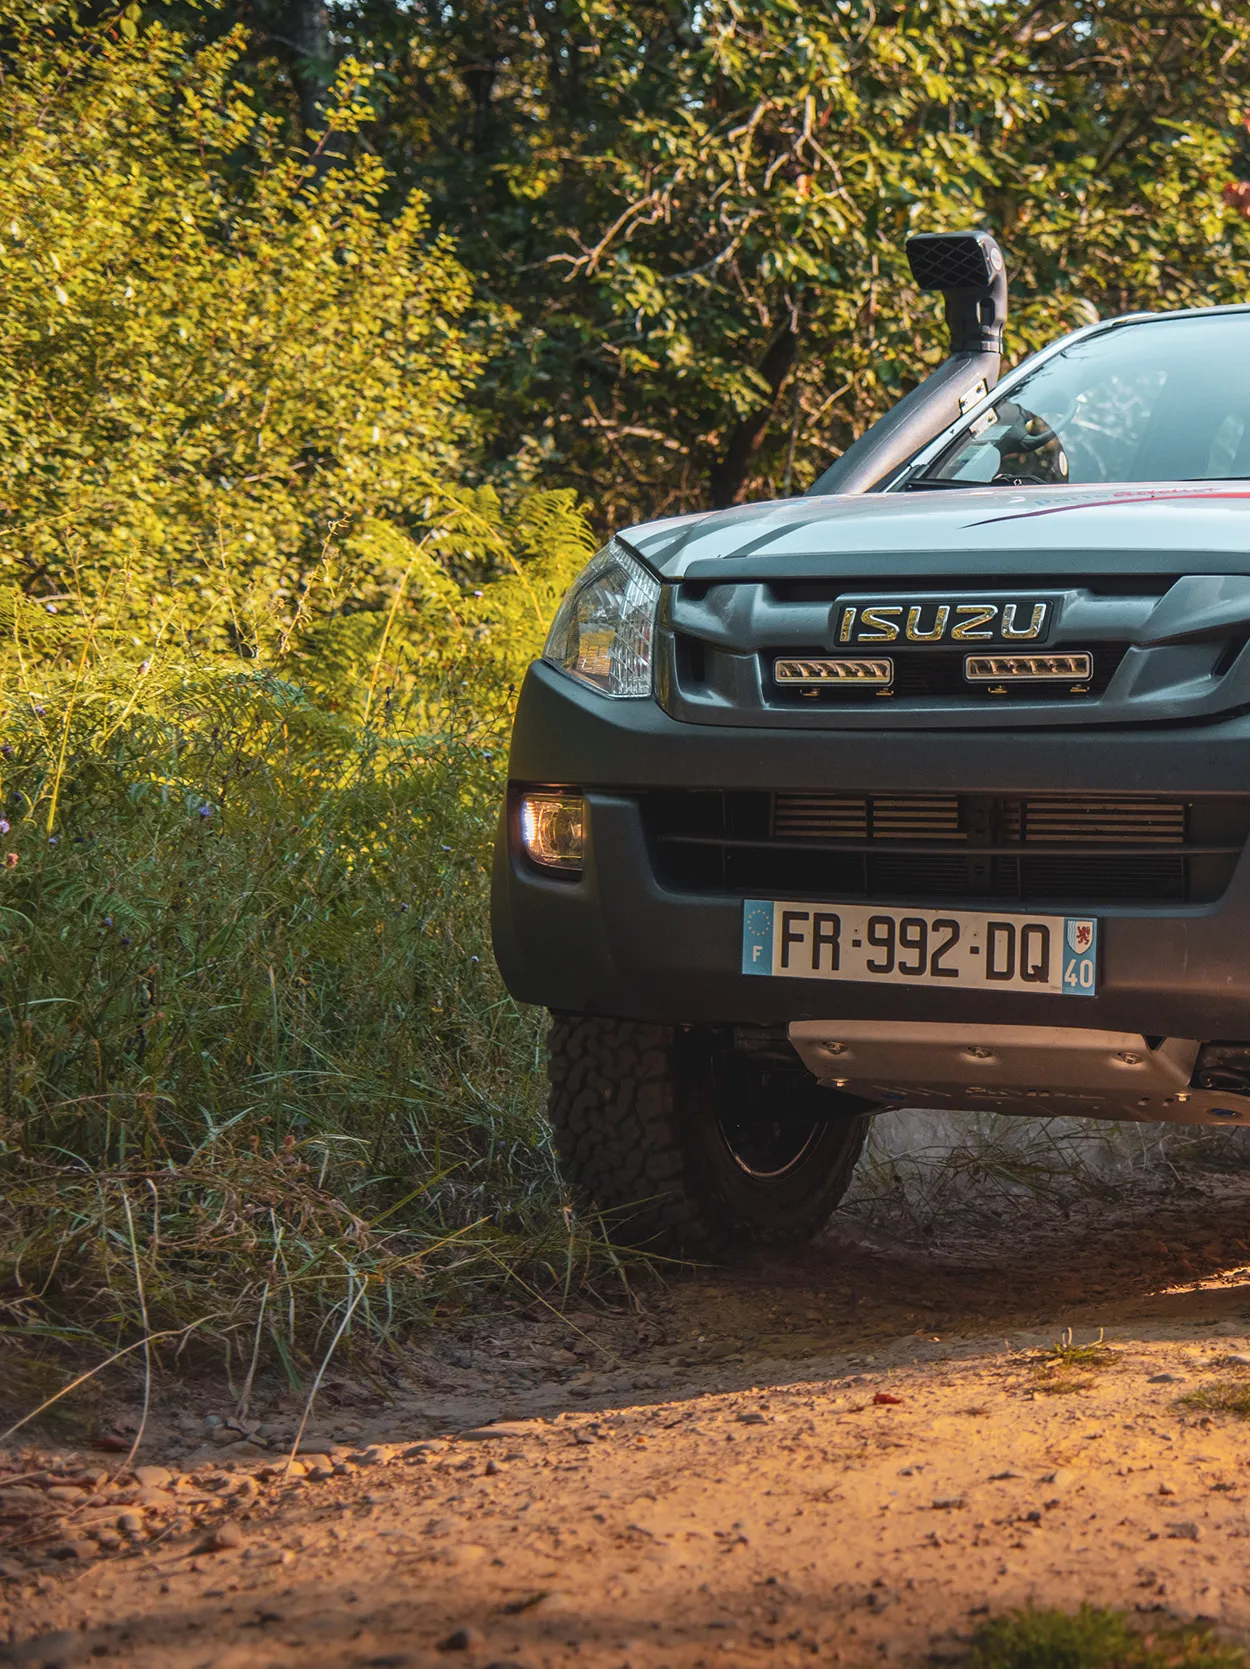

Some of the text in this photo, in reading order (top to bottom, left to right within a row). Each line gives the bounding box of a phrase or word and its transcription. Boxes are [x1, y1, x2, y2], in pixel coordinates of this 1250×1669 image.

[839, 602, 1047, 642] ISUZU
[752, 946, 763, 962] F
[781, 910, 1050, 983] FR-992-DQ
[1064, 959, 1094, 988] 40
